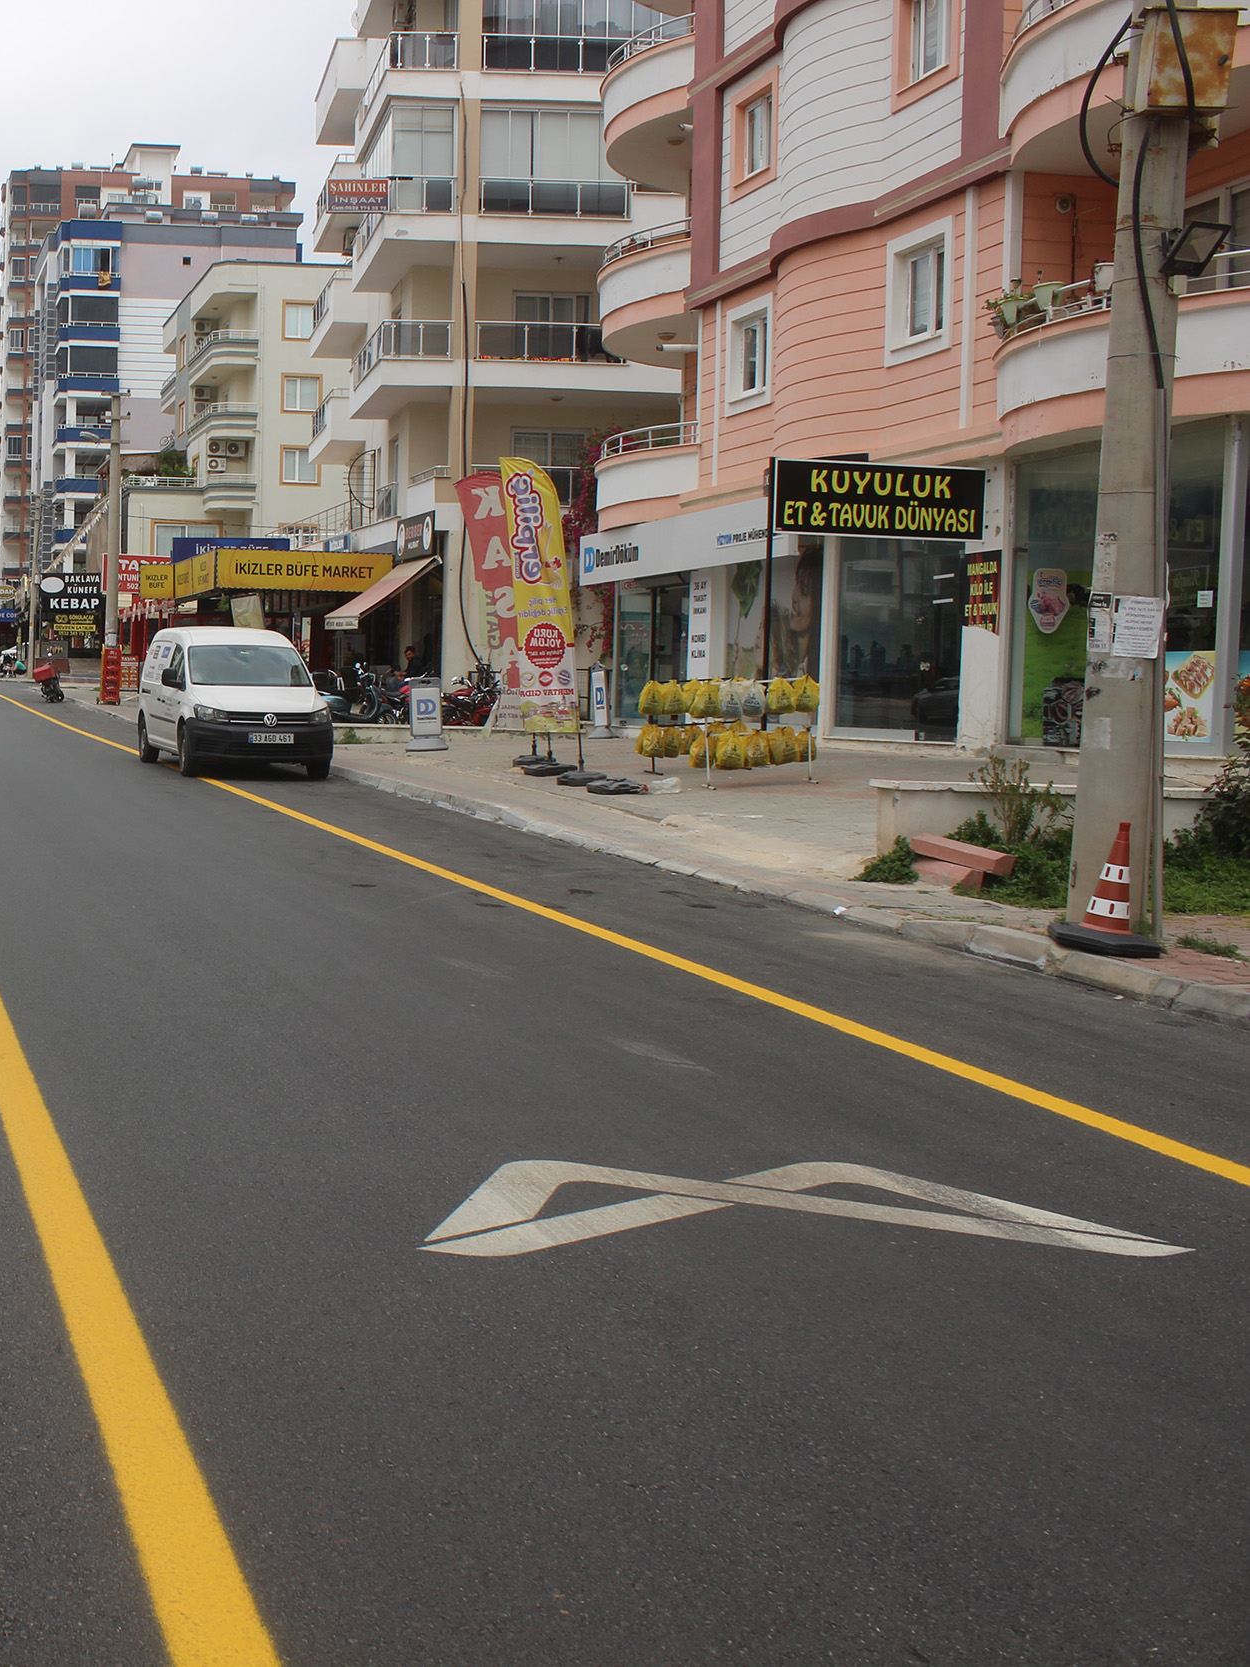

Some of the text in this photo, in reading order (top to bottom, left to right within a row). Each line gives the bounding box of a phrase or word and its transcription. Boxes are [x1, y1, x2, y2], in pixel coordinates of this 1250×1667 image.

[330, 181, 386, 194] ŞAHİNLER
[334, 195, 383, 205] İNŞAAT
[811, 469, 951, 499] KUYULUK
[783, 500, 976, 533] ET & TAVUK DÜNYASI
[732, 531, 747, 543] PROJE
[595, 543, 639, 568] DemirDöküm
[235, 560, 374, 579] İKİZLER BÜFE MARKET
[967, 561, 998, 576] MANGALDA
[64, 575, 100, 583] BAKLAVA
[117, 572, 139, 581] NTUNİ
[67, 583, 98, 594] KÜNEFE
[700, 581, 707, 590] AY
[970, 579, 993, 596] KİLO İLE
[50, 598, 100, 609] KEBAP
[964, 604, 972, 617] ET
[978, 602, 998, 616] TAVUK
[253, 734, 262, 742] 33
